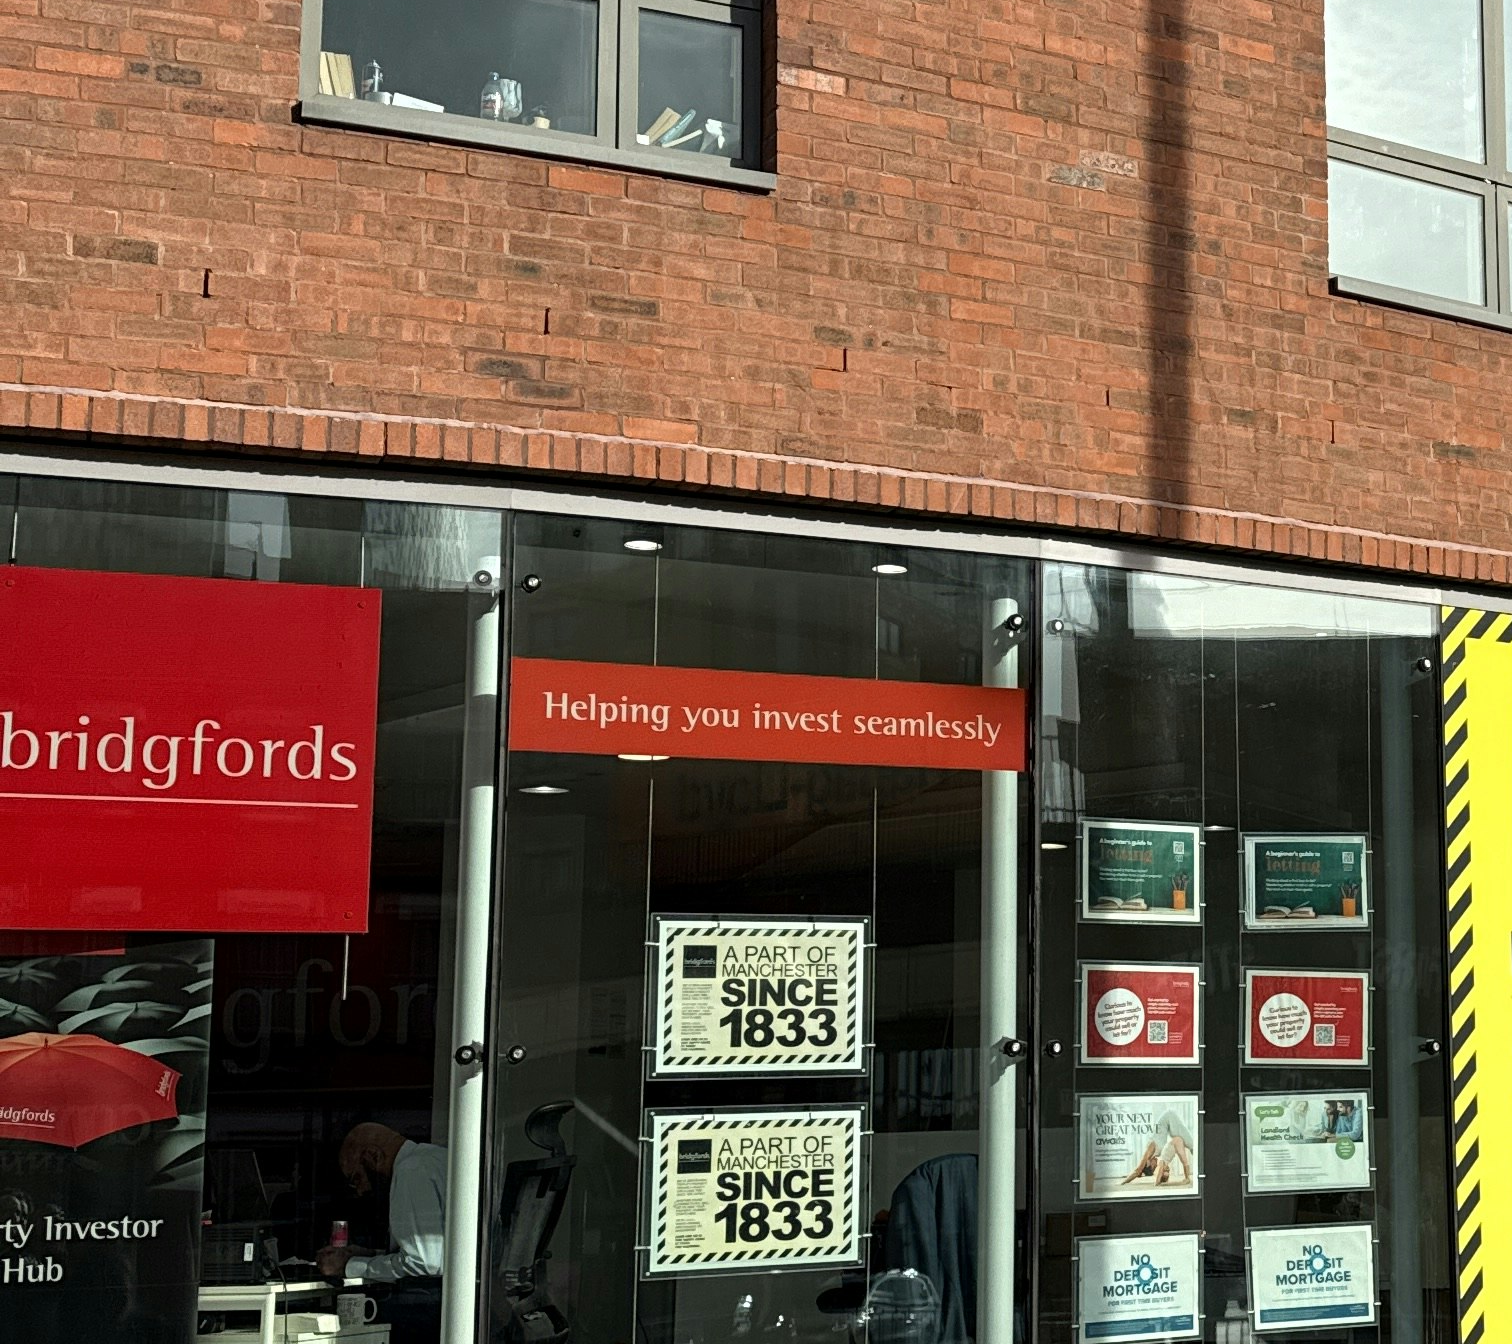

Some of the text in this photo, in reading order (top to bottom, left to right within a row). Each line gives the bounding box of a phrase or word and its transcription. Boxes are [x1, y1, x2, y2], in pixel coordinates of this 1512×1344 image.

[542, 690, 1002, 747] Helping you invest seamlessly
[0, 712, 358, 790] bridgfords
[723, 946, 836, 963] A PART OF
[721, 963, 838, 978] MANCHESTER
[720, 978, 838, 1008] SINCE
[719, 1008, 838, 1048] 1833
[1096, 1113, 1152, 1125] YOUR NEXT
[1096, 1124, 1161, 1136] GREAT MOVE
[1284, 1133, 1304, 1141] Check
[718, 1136, 833, 1156] A PART OF
[717, 1152, 834, 1171] MANCHESTER
[716, 1169, 835, 1201] SINCE
[46, 1216, 163, 1242] Investor
[714, 1199, 834, 1243] 1833
[1303, 1244, 1323, 1256] NO
[1130, 1254, 1151, 1266] NO
[3, 1257, 63, 1284] Hub
[1276, 1271, 1352, 1287] MORTGAGE
[1103, 1281, 1178, 1298] MORTGAGE
